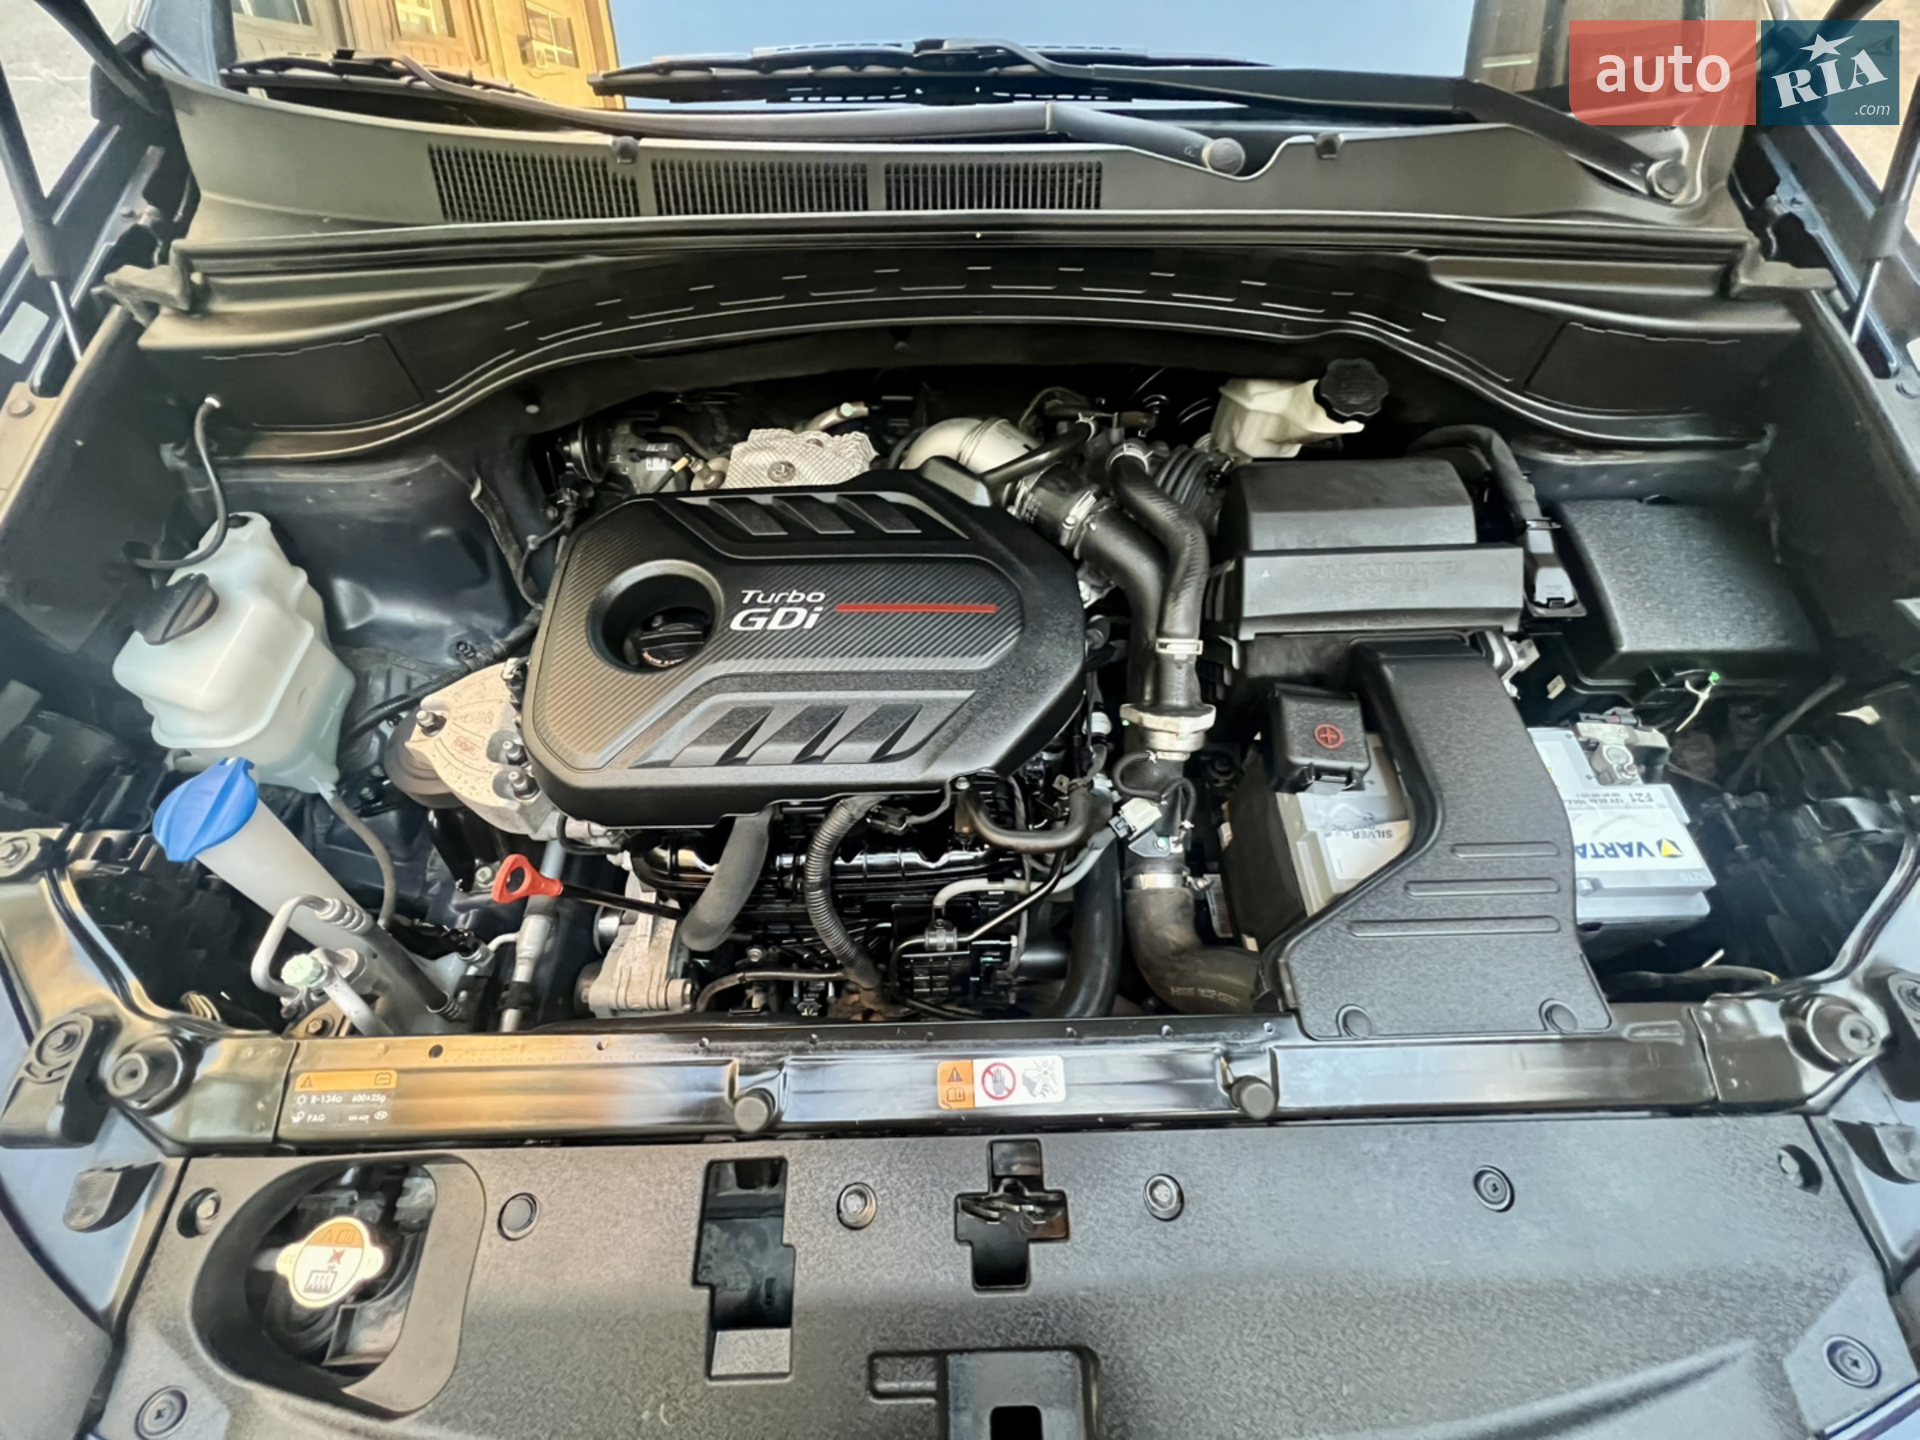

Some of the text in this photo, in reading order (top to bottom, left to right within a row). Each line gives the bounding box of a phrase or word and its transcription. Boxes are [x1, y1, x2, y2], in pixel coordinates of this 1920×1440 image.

[741, 589, 826, 604] Turbo
[729, 606, 824, 631] GDi
[1352, 828, 1394, 840] SILVER
[1574, 841, 1656, 859] VARTA
